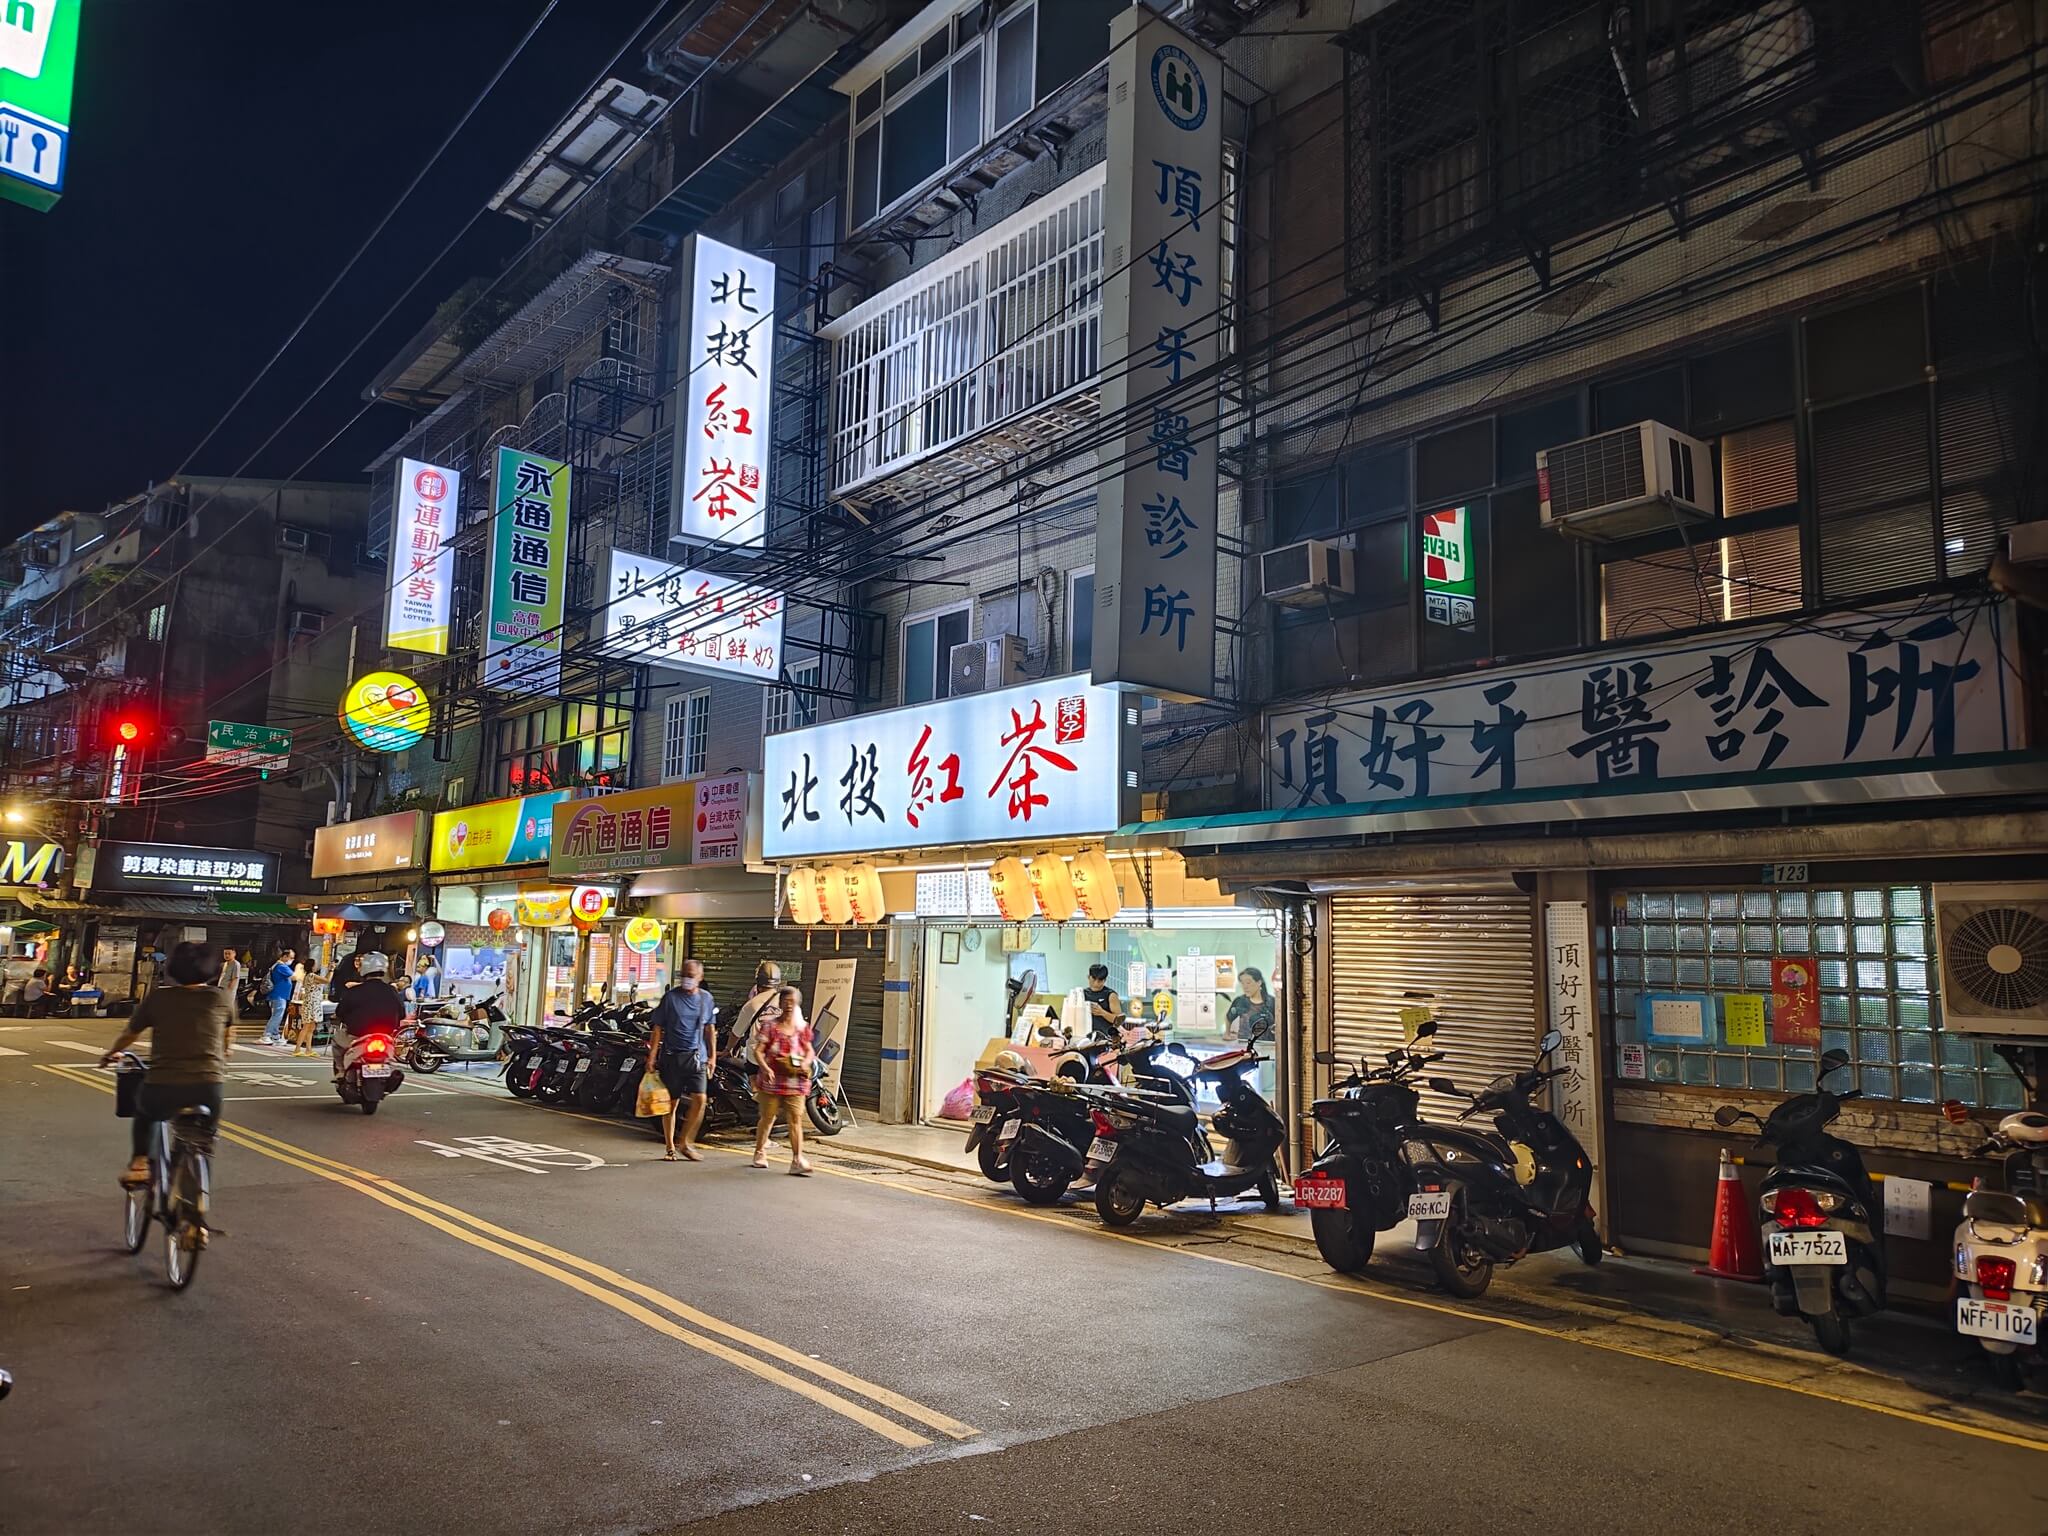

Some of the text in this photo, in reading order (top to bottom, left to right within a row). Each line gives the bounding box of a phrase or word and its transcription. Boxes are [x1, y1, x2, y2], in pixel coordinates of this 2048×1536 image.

[692, 269, 759, 521] 北投紅茶
[1140, 159, 1203, 652] 頂好牙醫診所
[511, 461, 553, 605] 永通通信
[408, 502, 442, 601] 運動彩券
[404, 606, 433, 616] SPORTS
[405, 600, 433, 609] TAIWAN
[618, 566, 773, 629] 北投紅茶
[403, 613, 435, 623] LOTTERY
[618, 614, 774, 669] 黑糖粉圓鮮奶
[1276, 616, 1981, 806] 頂好牙醫診所
[782, 699, 1078, 832] 北投紅茶
[711, 782, 740, 796] 中華電信
[709, 808, 741, 824] 台灣大哥大
[571, 805, 672, 857] 永通通信
[122, 855, 265, 880] 剪燙染護造型沙龍
[1777, 865, 1806, 881] 123
[240, 879, 263, 887] SALON
[1554, 943, 1587, 1127] 頂好牙醫診所
[1295, 1186, 1343, 1201] LGR-2287
[1408, 1199, 1449, 1217] 686-KCJ
[1772, 1240, 1843, 1257] MAF-7522
[1960, 1307, 2033, 1336] NFF-1102
